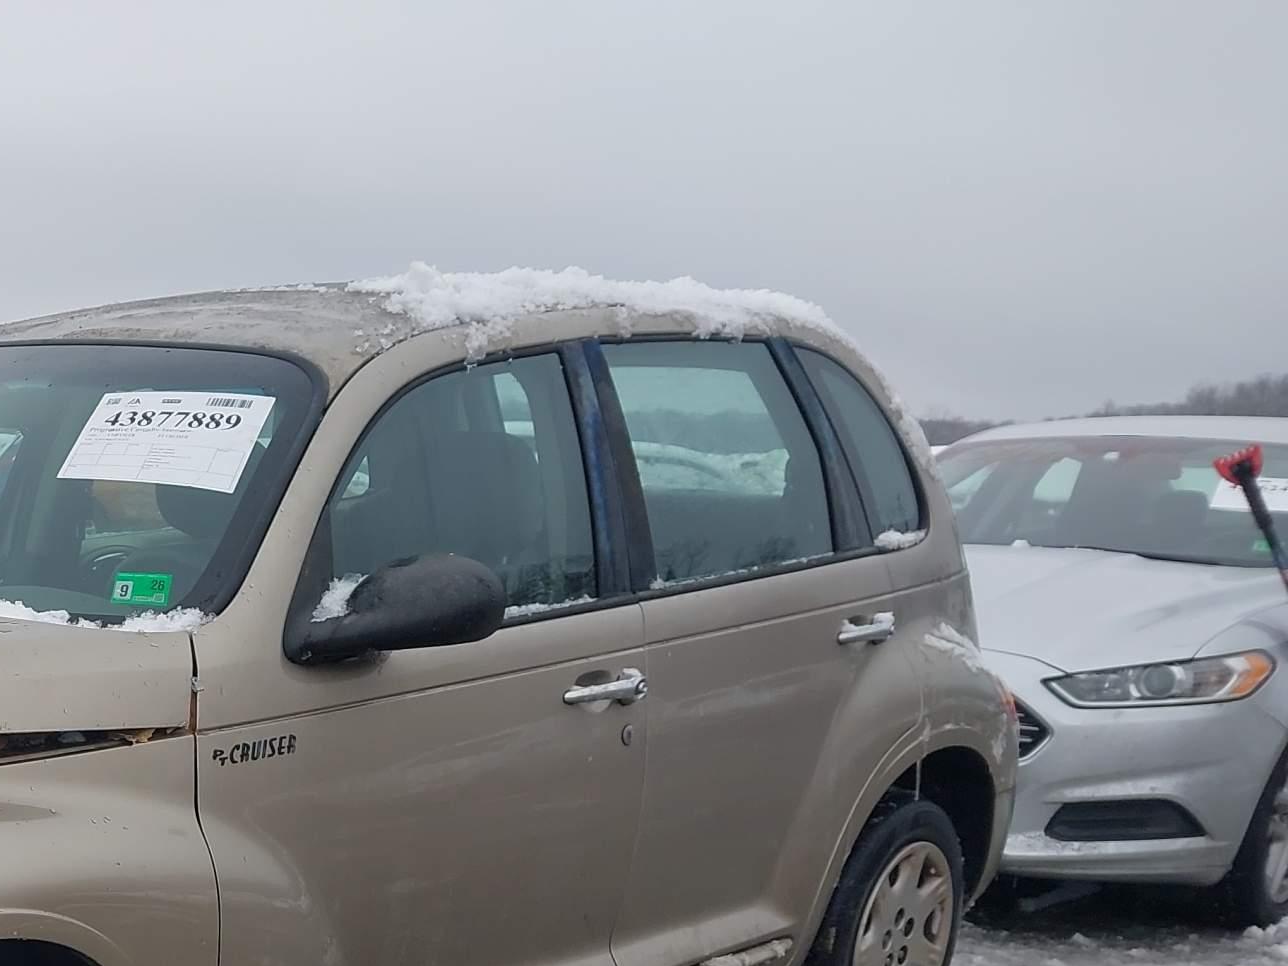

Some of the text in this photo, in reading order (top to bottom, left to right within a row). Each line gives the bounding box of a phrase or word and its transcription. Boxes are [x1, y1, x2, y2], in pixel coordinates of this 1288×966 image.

[104, 410, 242, 430] 43877889
[119, 584, 129, 598] 9
[211, 734, 297, 766] PT CRUISER
